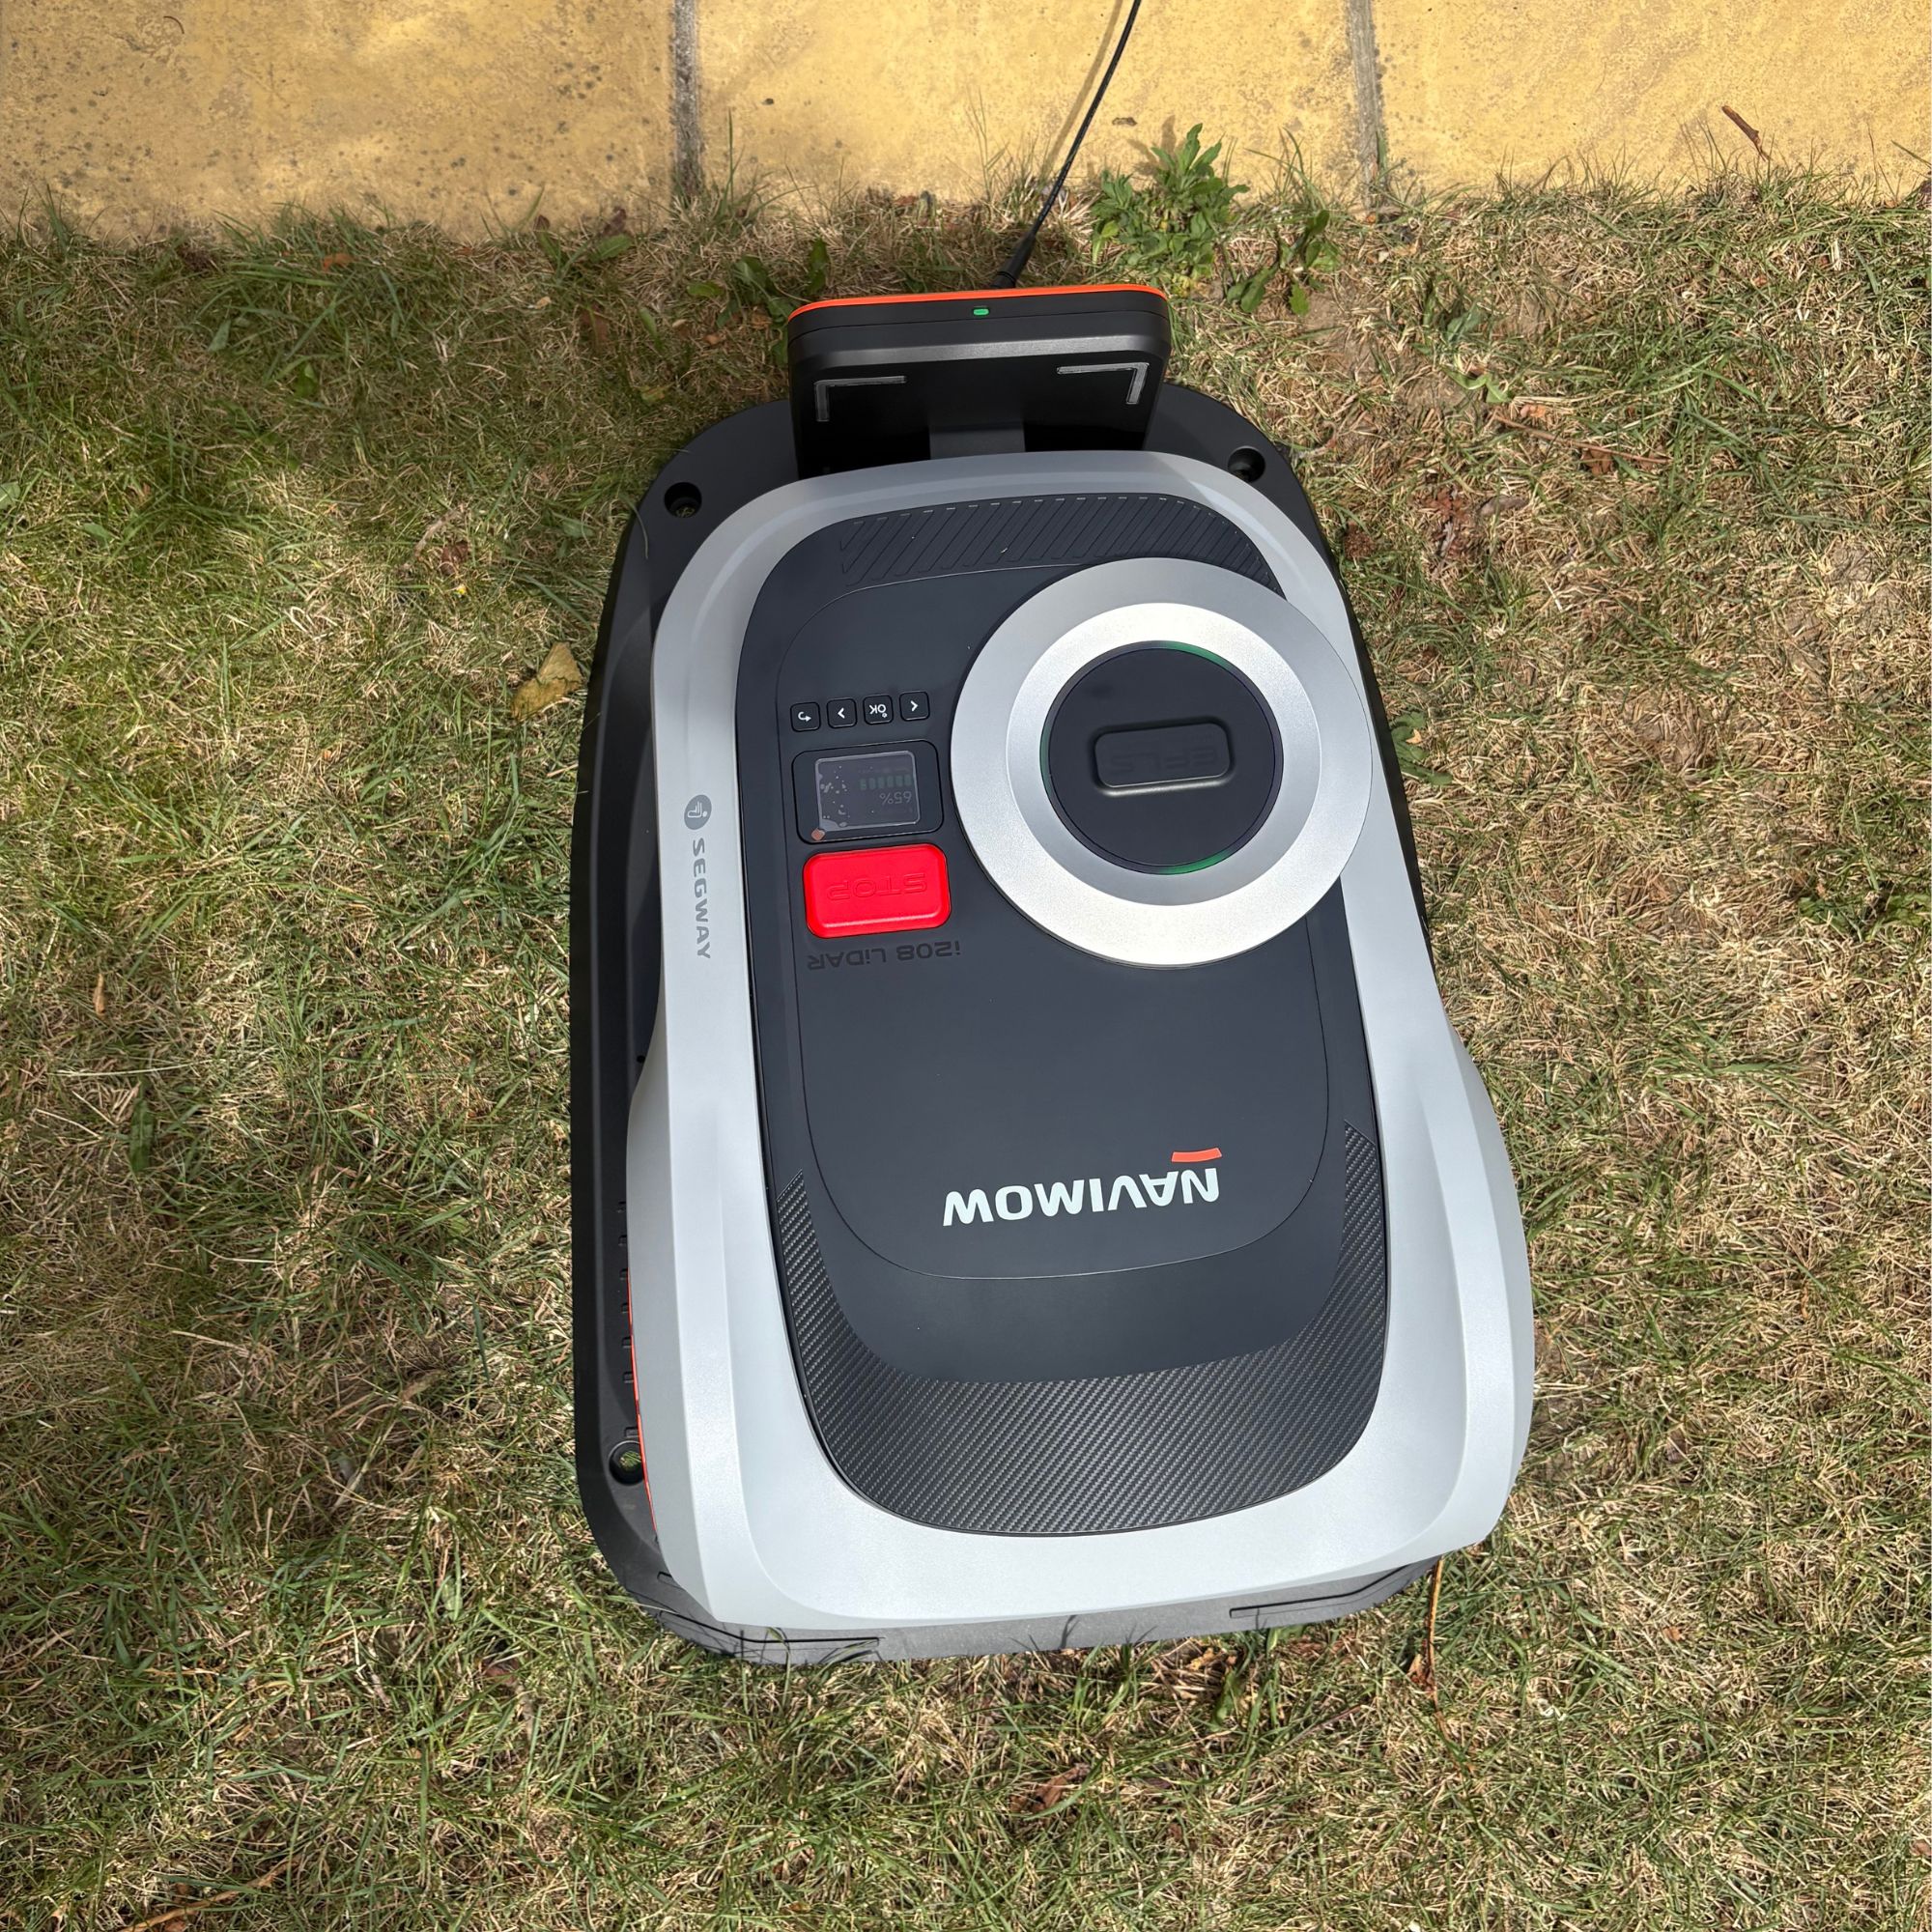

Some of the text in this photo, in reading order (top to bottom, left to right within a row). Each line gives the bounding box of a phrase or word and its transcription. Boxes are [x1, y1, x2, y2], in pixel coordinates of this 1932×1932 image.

[869, 703, 887, 714] OK
[879, 790, 912, 806] 65%
[693, 838, 711, 958] SEGWAY
[827, 872, 927, 900] STOP
[807, 940, 961, 971] i208 LiDAR
[943, 1167, 1220, 1226] NAVIMOW
